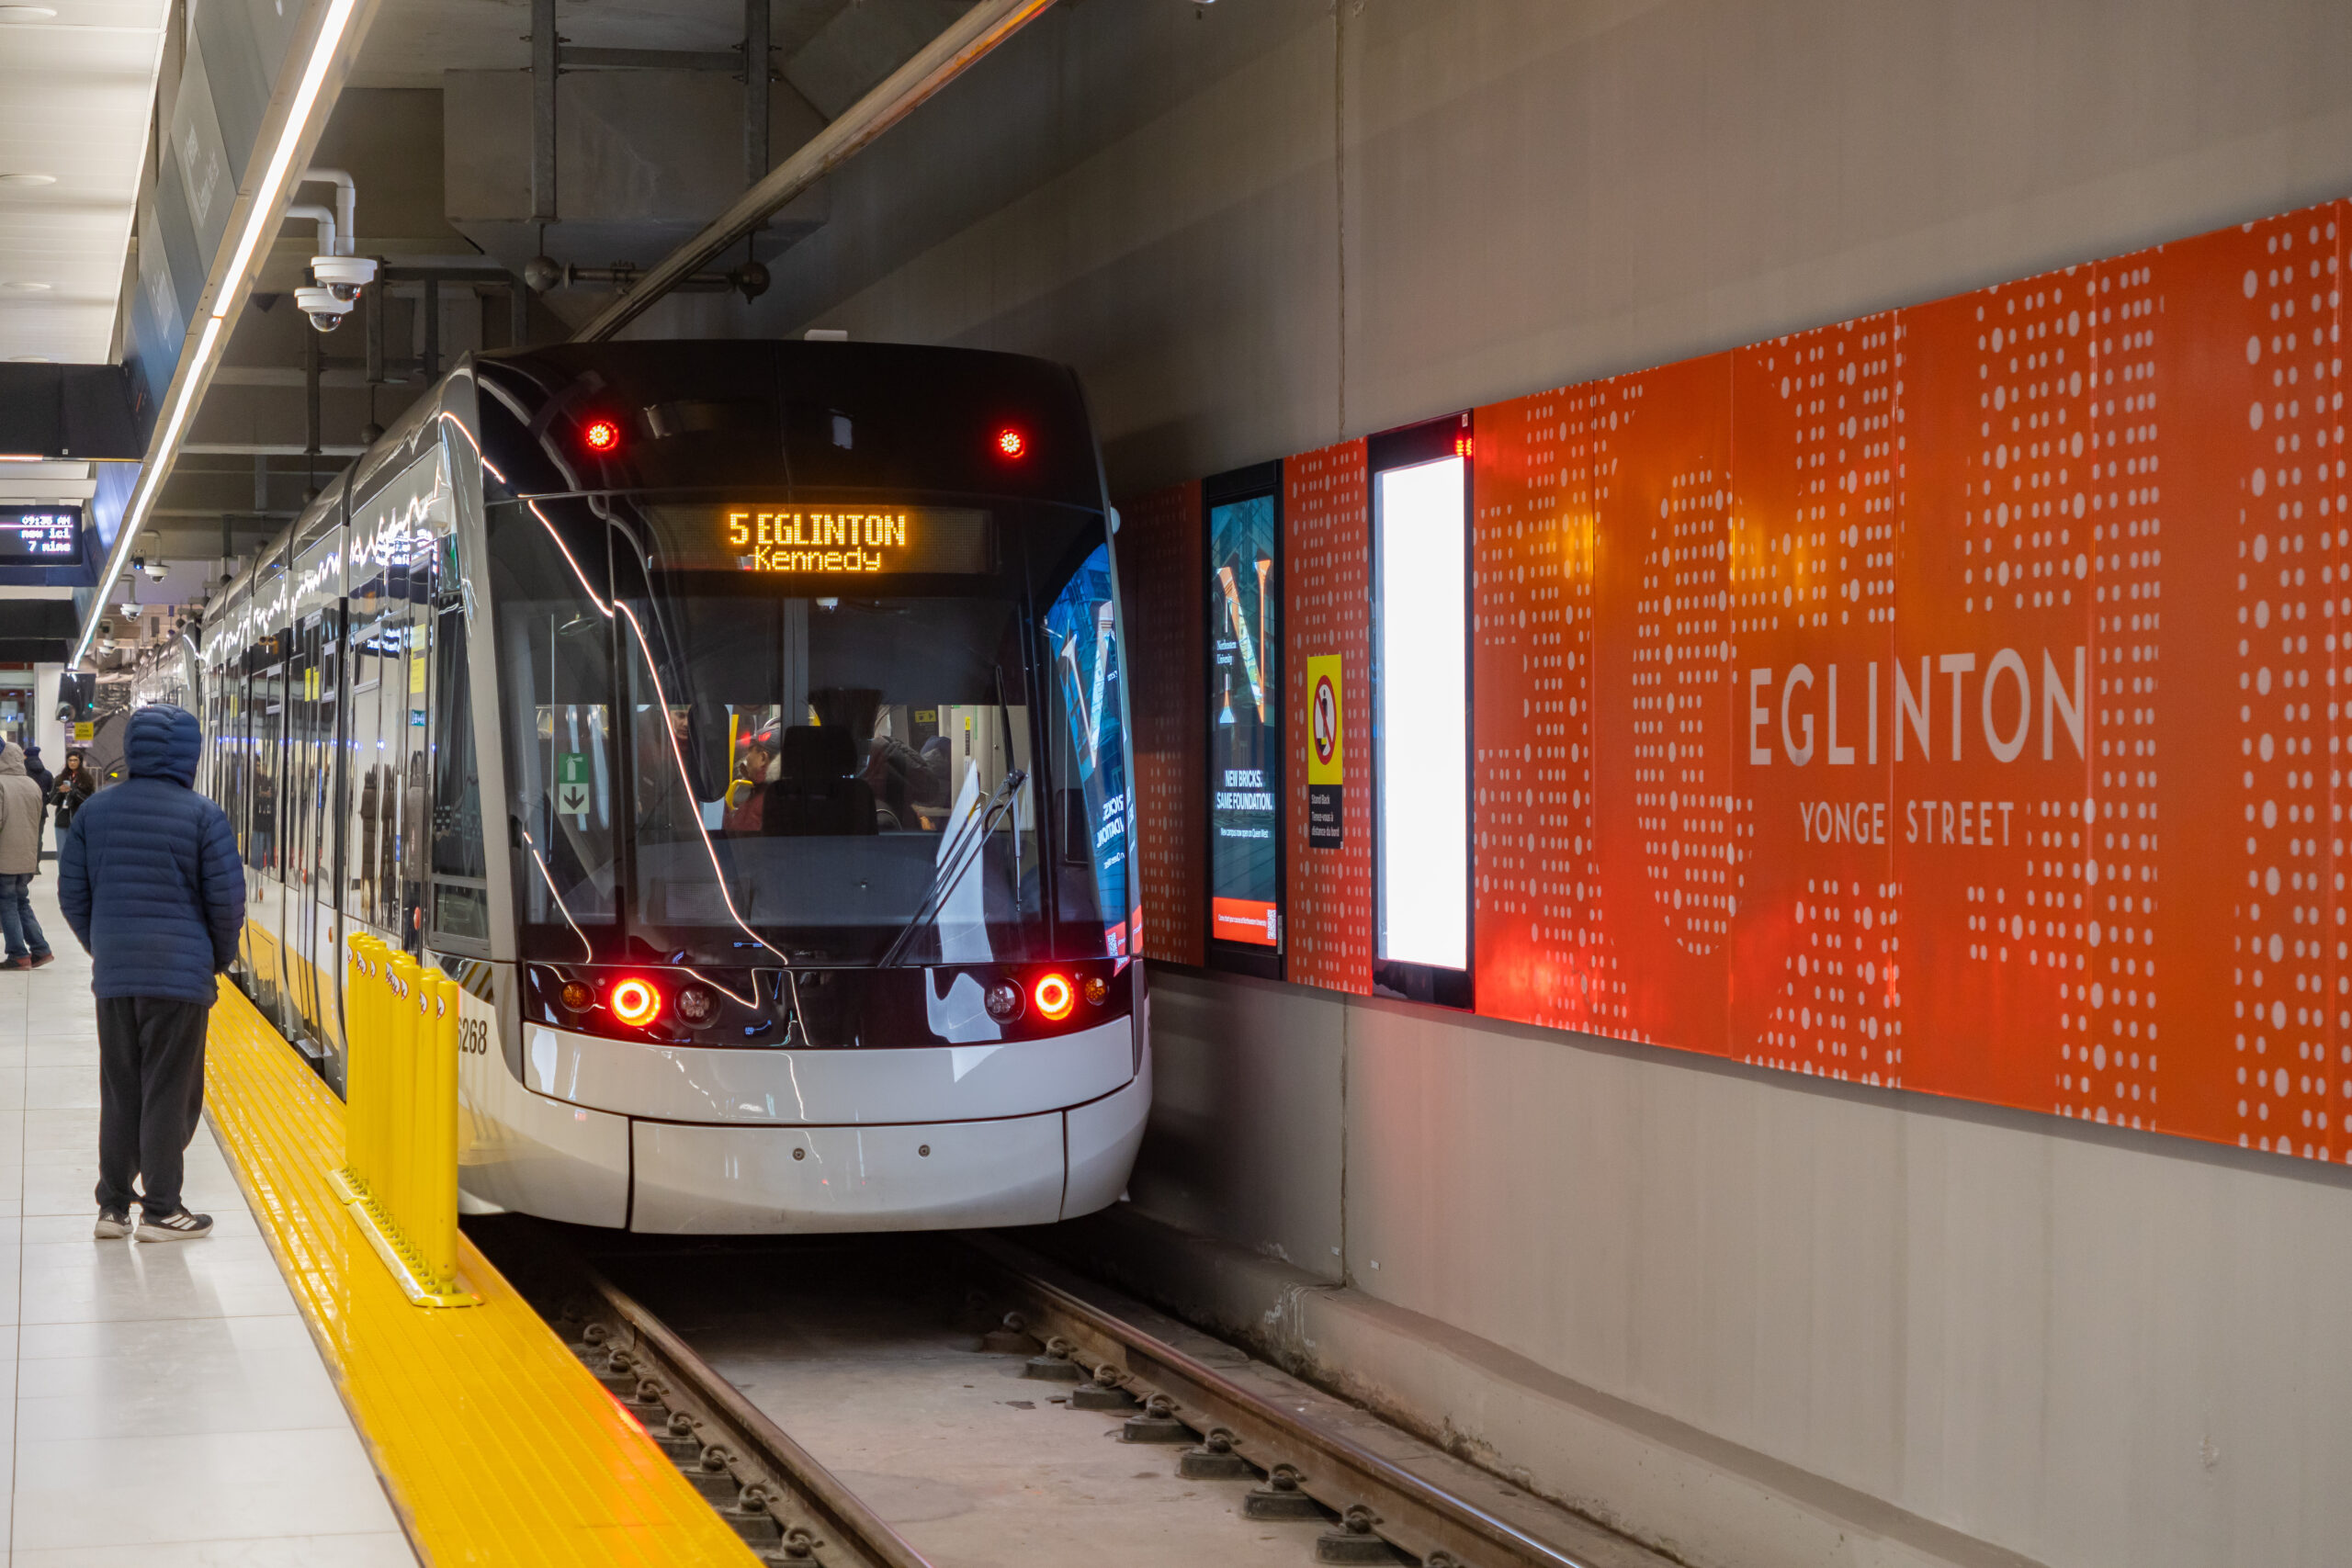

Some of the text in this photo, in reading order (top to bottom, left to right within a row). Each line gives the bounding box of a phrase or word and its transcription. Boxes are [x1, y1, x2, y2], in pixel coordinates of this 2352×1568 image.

[57, 515, 71, 525] AM
[729, 513, 905, 546] 5 EGLINTON
[28, 540, 37, 552] 7
[754, 545, 881, 571] Kennedy
[1750, 646, 2086, 767] EGLINTON
[1225, 770, 1263, 788] NEW BRICKS.
[1216, 792, 1272, 810] SAME FOUNDATION.
[1800, 799, 2014, 846] YONGE STREET
